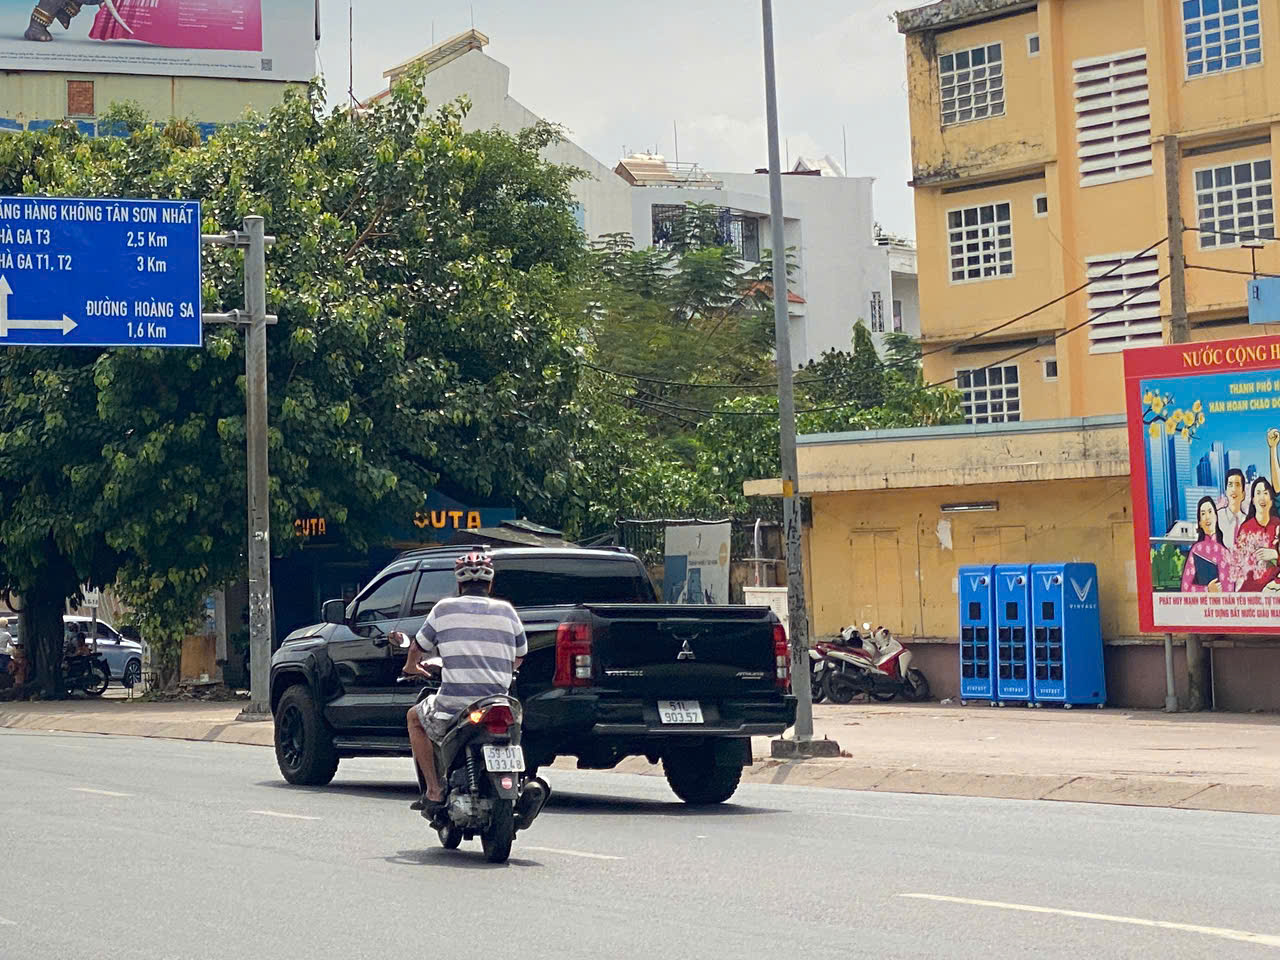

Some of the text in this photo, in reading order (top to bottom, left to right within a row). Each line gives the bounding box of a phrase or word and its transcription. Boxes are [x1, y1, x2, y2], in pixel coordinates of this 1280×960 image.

[24, 201, 57, 221] HÀNG
[61, 202, 102, 222] KHÔNG
[106, 203, 128, 223] TÂN
[133, 207, 157, 223] SƠN
[162, 203, 194, 224] NHẤT
[17, 229, 33, 245] GA
[36, 229, 51, 245] T3
[148, 231, 168, 247] Km
[17, 253, 33, 270] GA
[57, 255, 72, 271] T2
[137, 256, 144, 272] 3
[147, 256, 167, 272] Km
[86, 296, 194, 318] ĐƯỜNG HOÀNG SA
[147, 322, 167, 338] Km
[1183, 345, 1223, 368] NƯỚC
[1225, 344, 1267, 367] CỘNG
